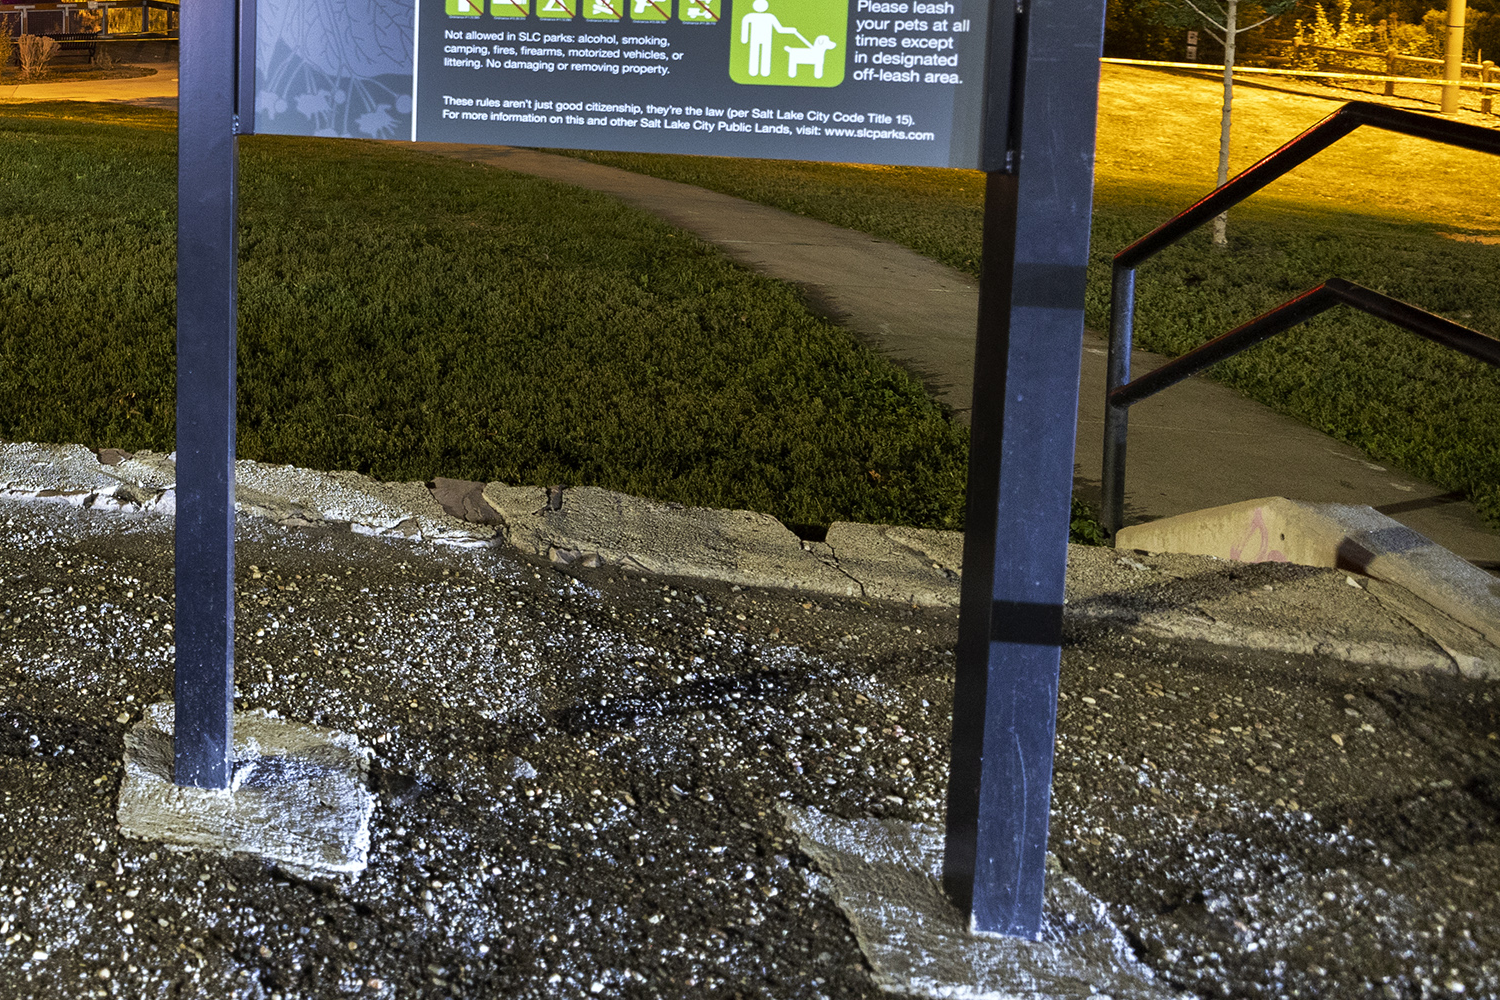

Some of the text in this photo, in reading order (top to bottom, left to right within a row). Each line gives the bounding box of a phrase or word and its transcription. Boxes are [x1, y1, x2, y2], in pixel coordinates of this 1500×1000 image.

[857, 0, 954, 14] Please leash
[856, 18, 970, 33] your pets at all
[444, 29, 670, 48] Not allowed in SLC parks: alcohol, smoking,
[854, 33, 954, 51] times except
[444, 44, 684, 61] camping, fires, firearms, motorized vehicles, or
[854, 50, 958, 68] in designated
[444, 57, 670, 76] littering. No damaging or removing property.
[853, 67, 963, 84] off-leash area.
[442, 95, 915, 127] These rules aren't just good citizenship, they're the law (per Salt Lake City Code Title 15).
[442, 109, 934, 141] For more information on this and other Salt Lake City Public Lands, visit: www.slcparks.com
